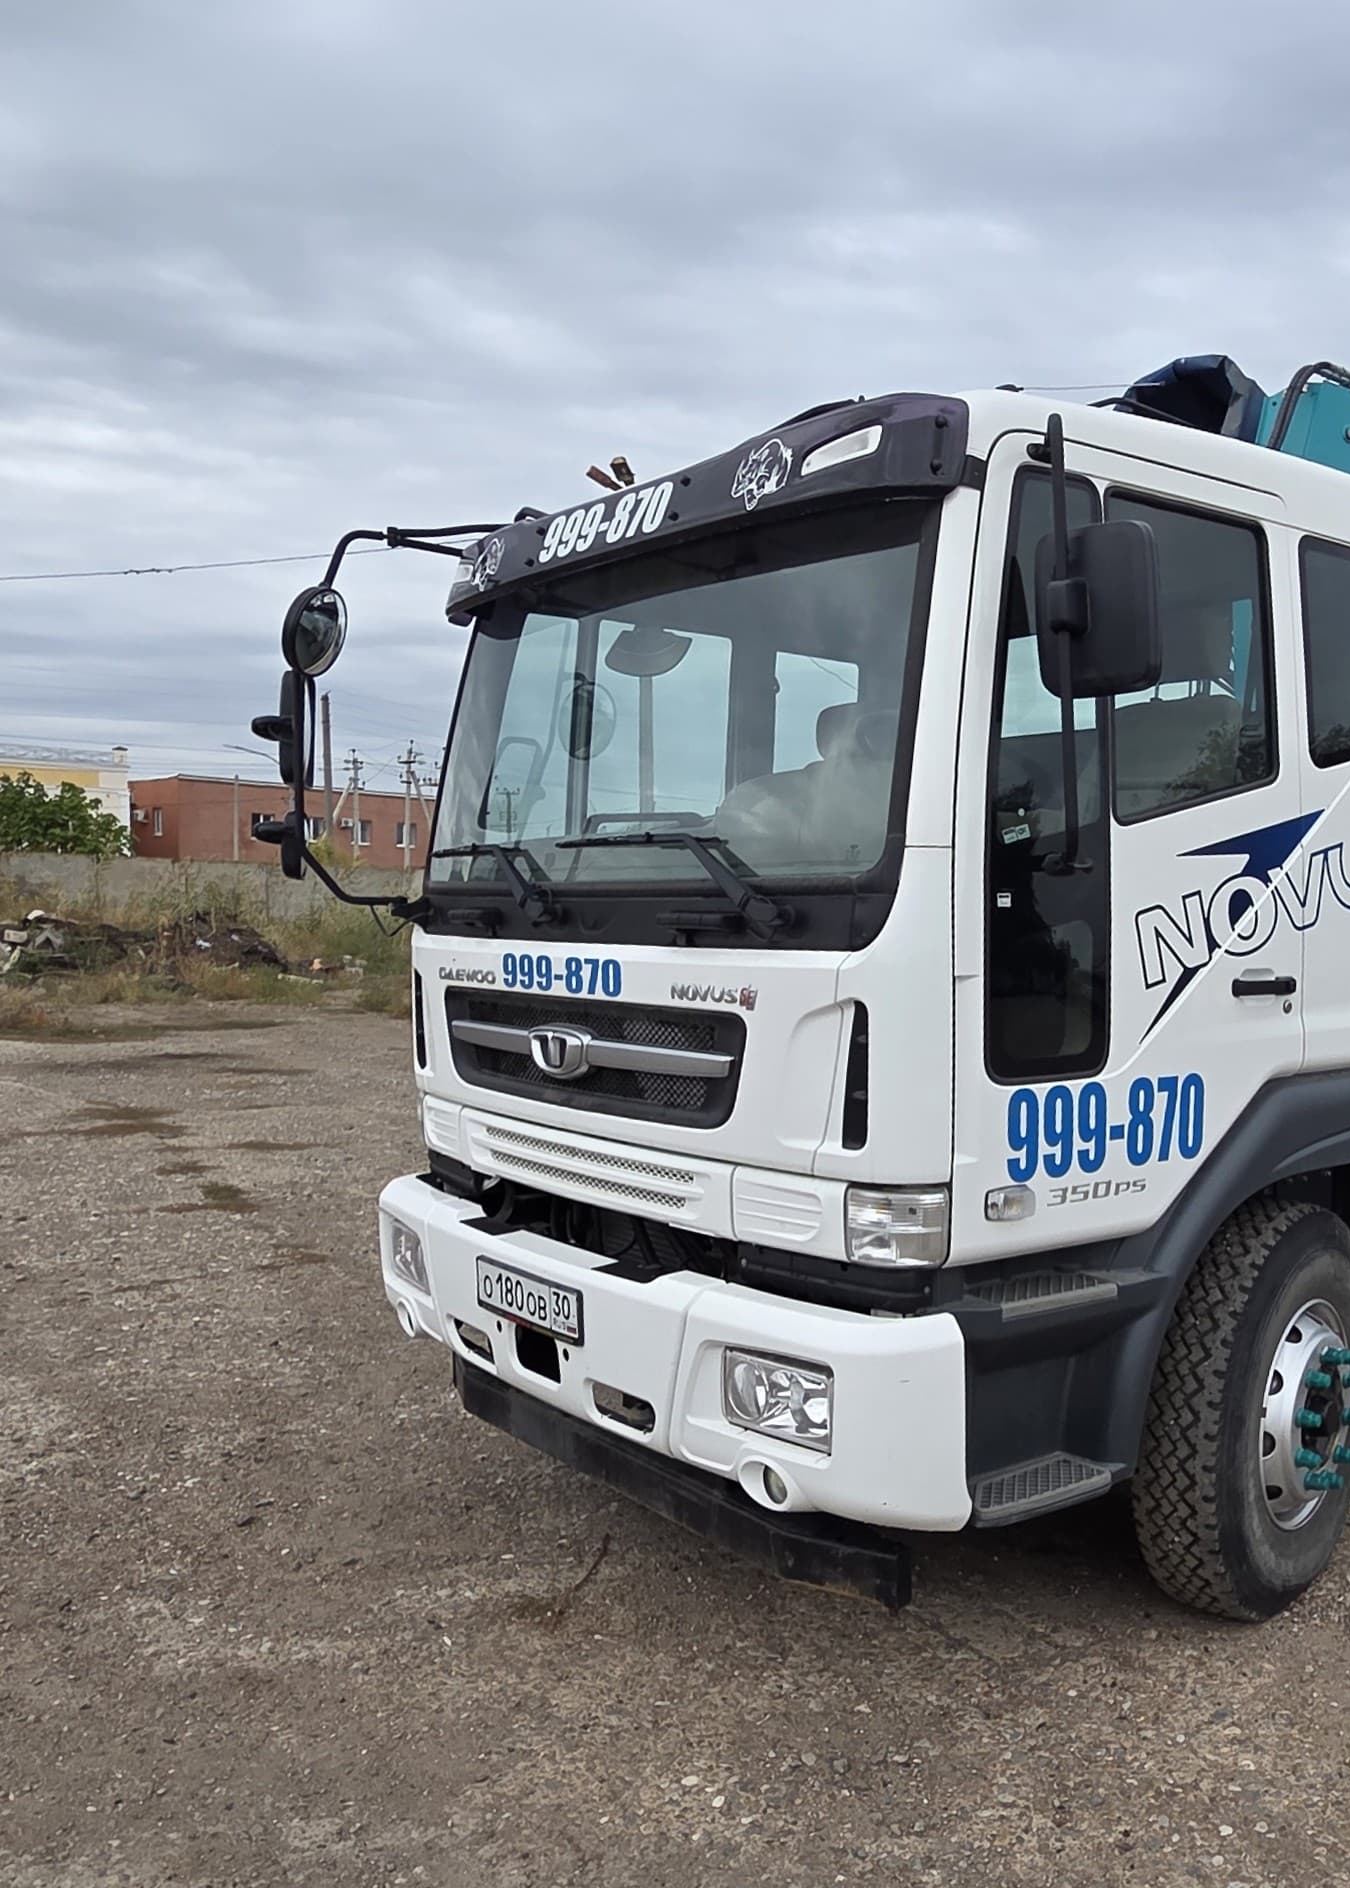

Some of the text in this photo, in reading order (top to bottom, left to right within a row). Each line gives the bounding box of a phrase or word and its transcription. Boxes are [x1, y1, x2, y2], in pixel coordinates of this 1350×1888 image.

[538, 480, 675, 565] 999-870
[438, 966, 497, 985] DAEWOO
[502, 952, 622, 998] 999-870
[670, 981, 738, 1004] NOVUS
[1006, 1072, 1207, 1183] 999-870
[552, 1291, 571, 1321] 30
